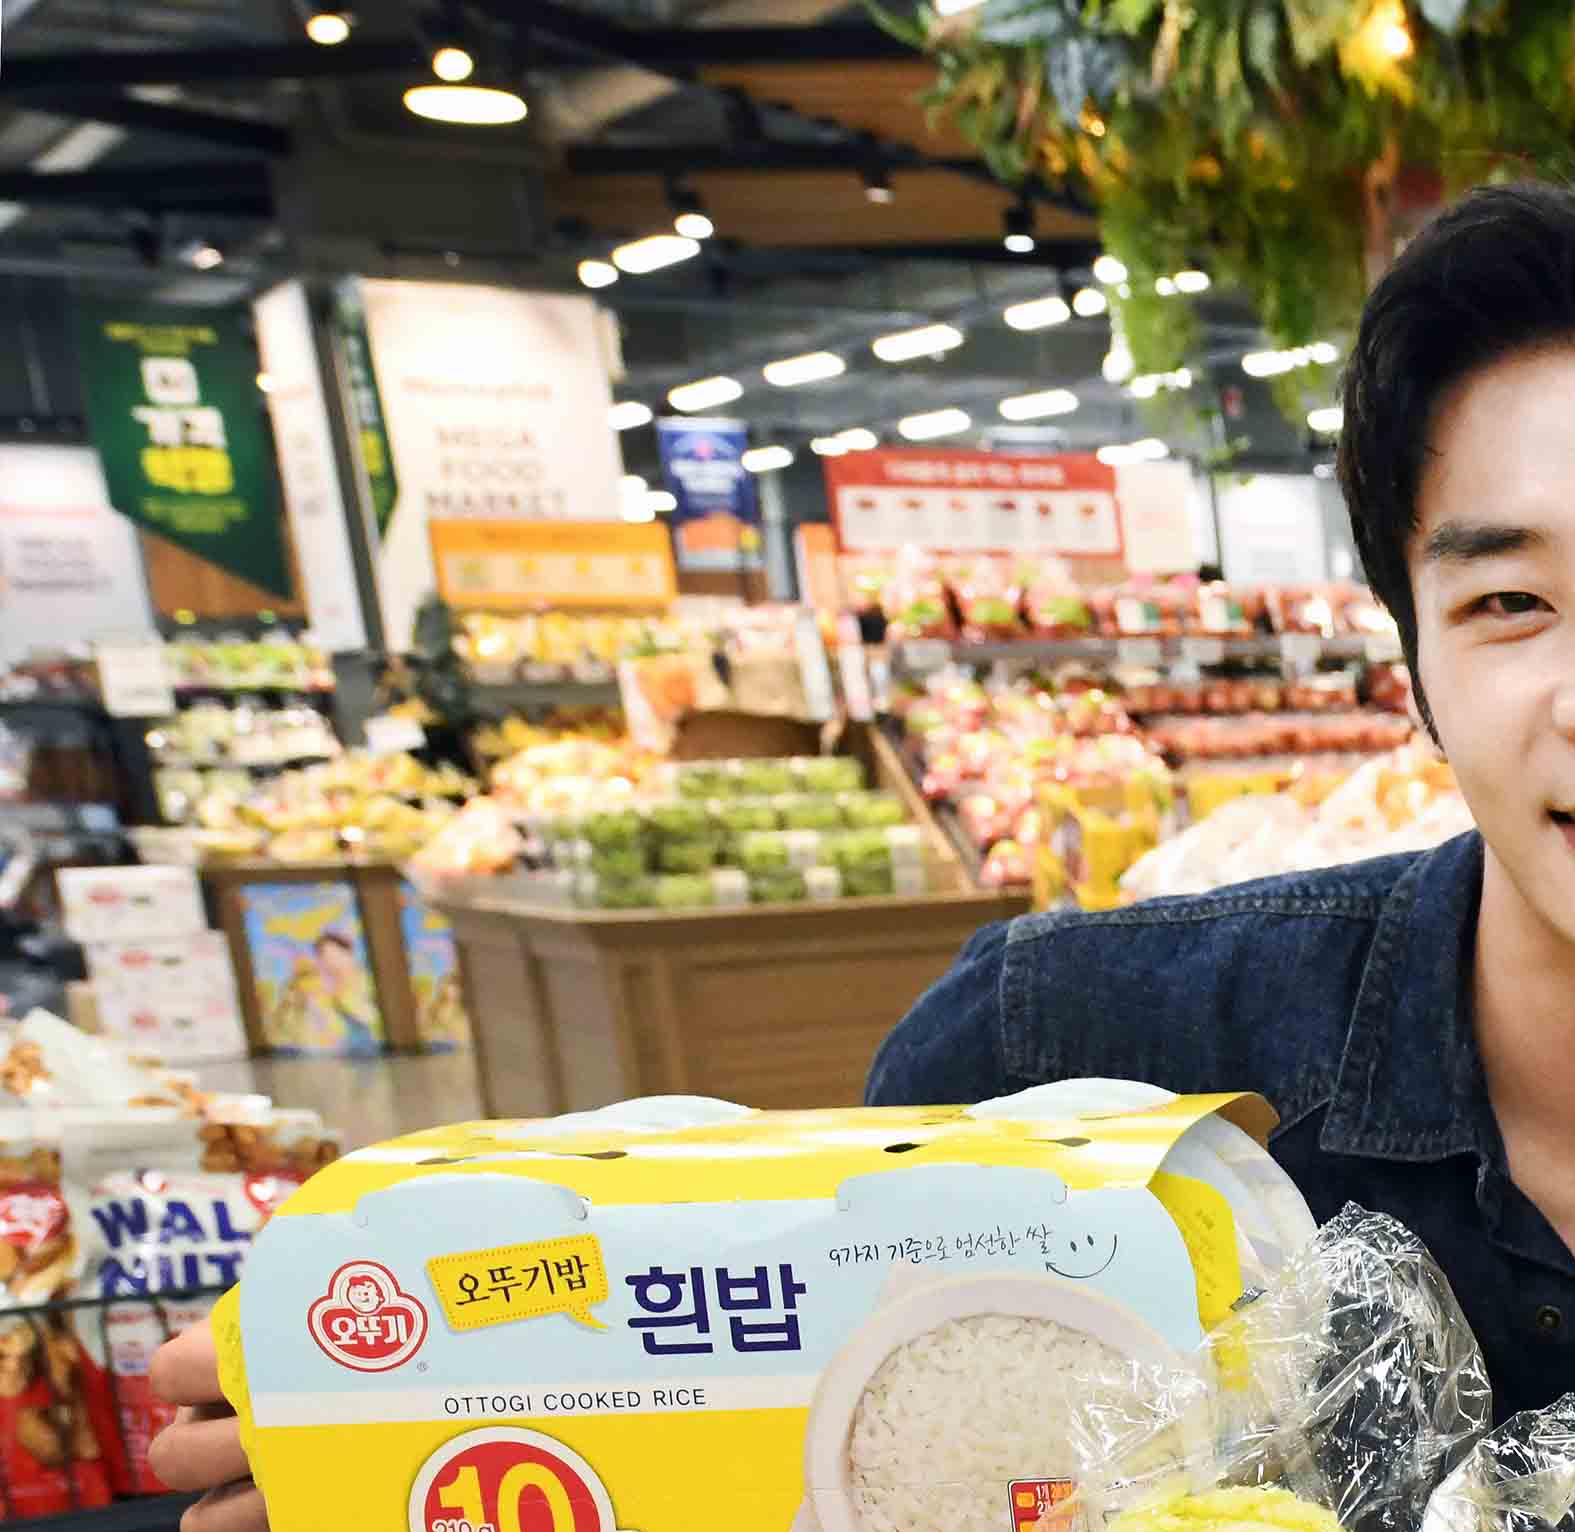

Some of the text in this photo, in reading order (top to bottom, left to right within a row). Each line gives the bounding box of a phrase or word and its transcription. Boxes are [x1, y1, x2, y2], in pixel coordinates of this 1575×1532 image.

[91, 1197, 254, 1249] WAL
[828, 1222, 1053, 1265] 9가지 기준으로 엄선한 쌀
[455, 1254, 592, 1308] 오뚜기밥
[330, 1315, 409, 1348] 오뚜기
[625, 1262, 807, 1356] 흰밥
[444, 1387, 707, 1416] OTTOGI COOKED RICE
